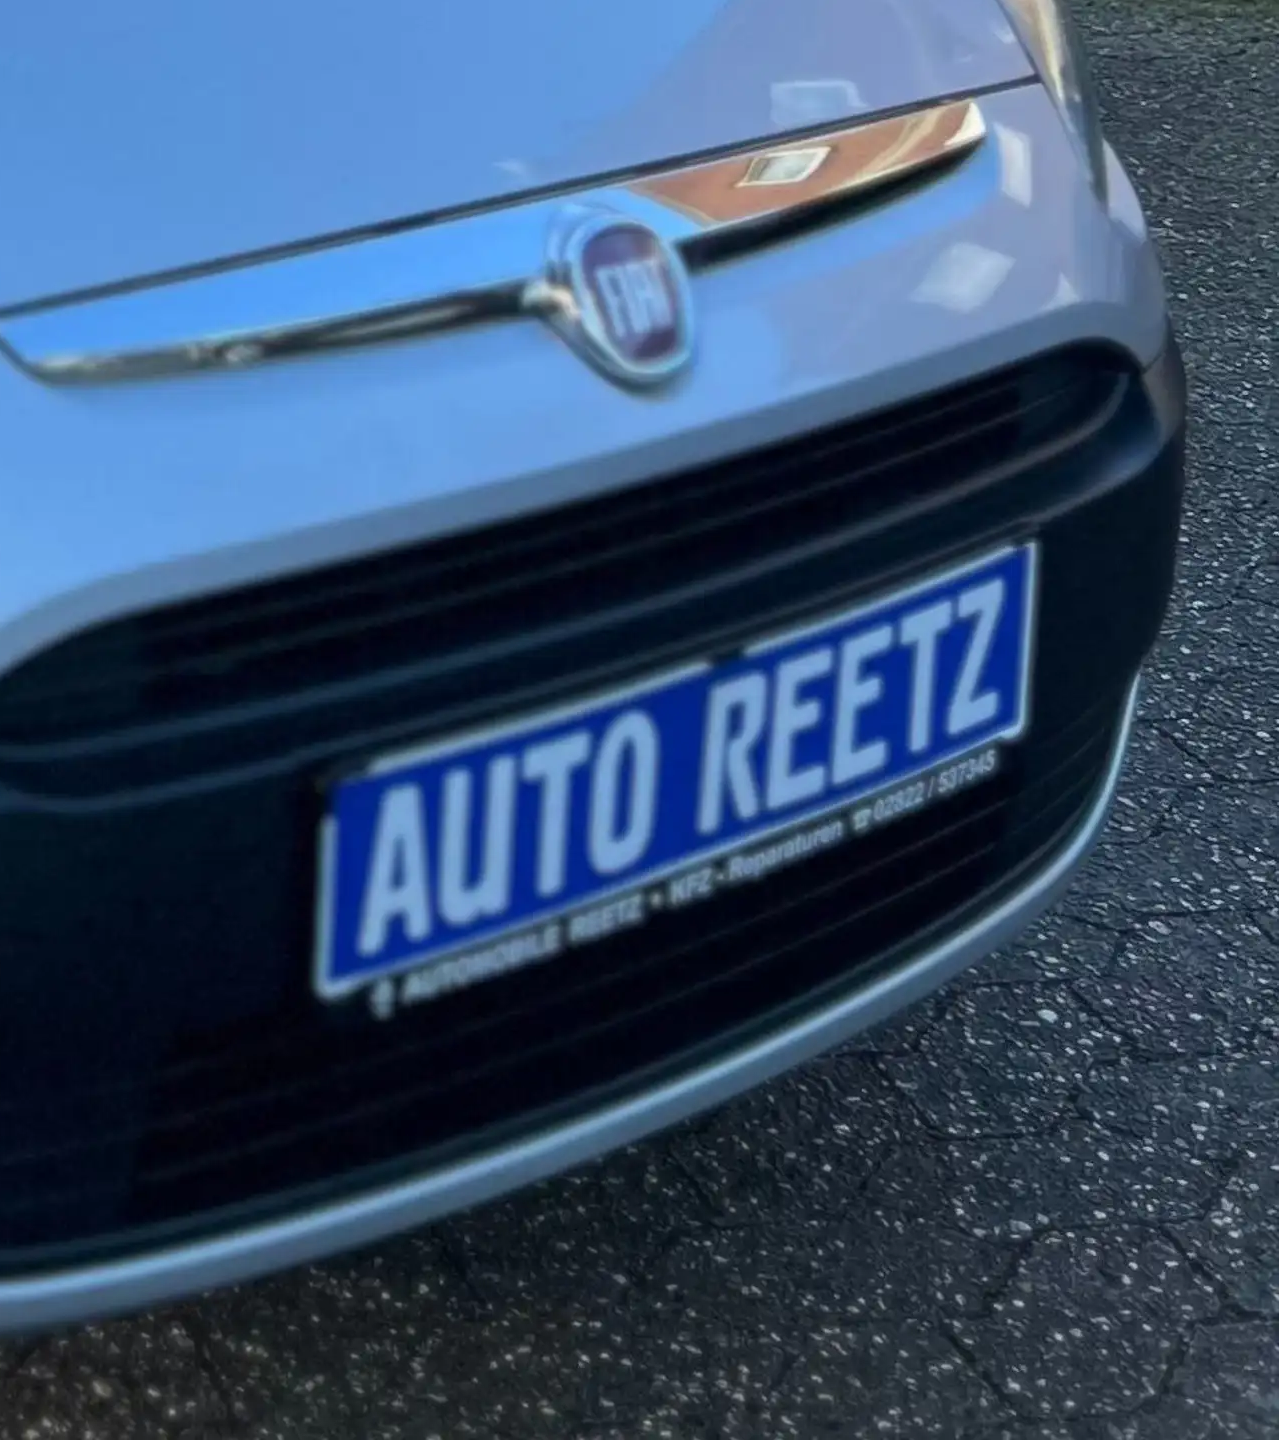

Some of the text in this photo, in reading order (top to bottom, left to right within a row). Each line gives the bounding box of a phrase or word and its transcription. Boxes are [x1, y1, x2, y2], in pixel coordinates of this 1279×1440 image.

[356, 577, 1006, 957] AUTO REETZ
[402, 921, 562, 1005] AUTOMOBILE
[568, 893, 644, 942] REETZ
